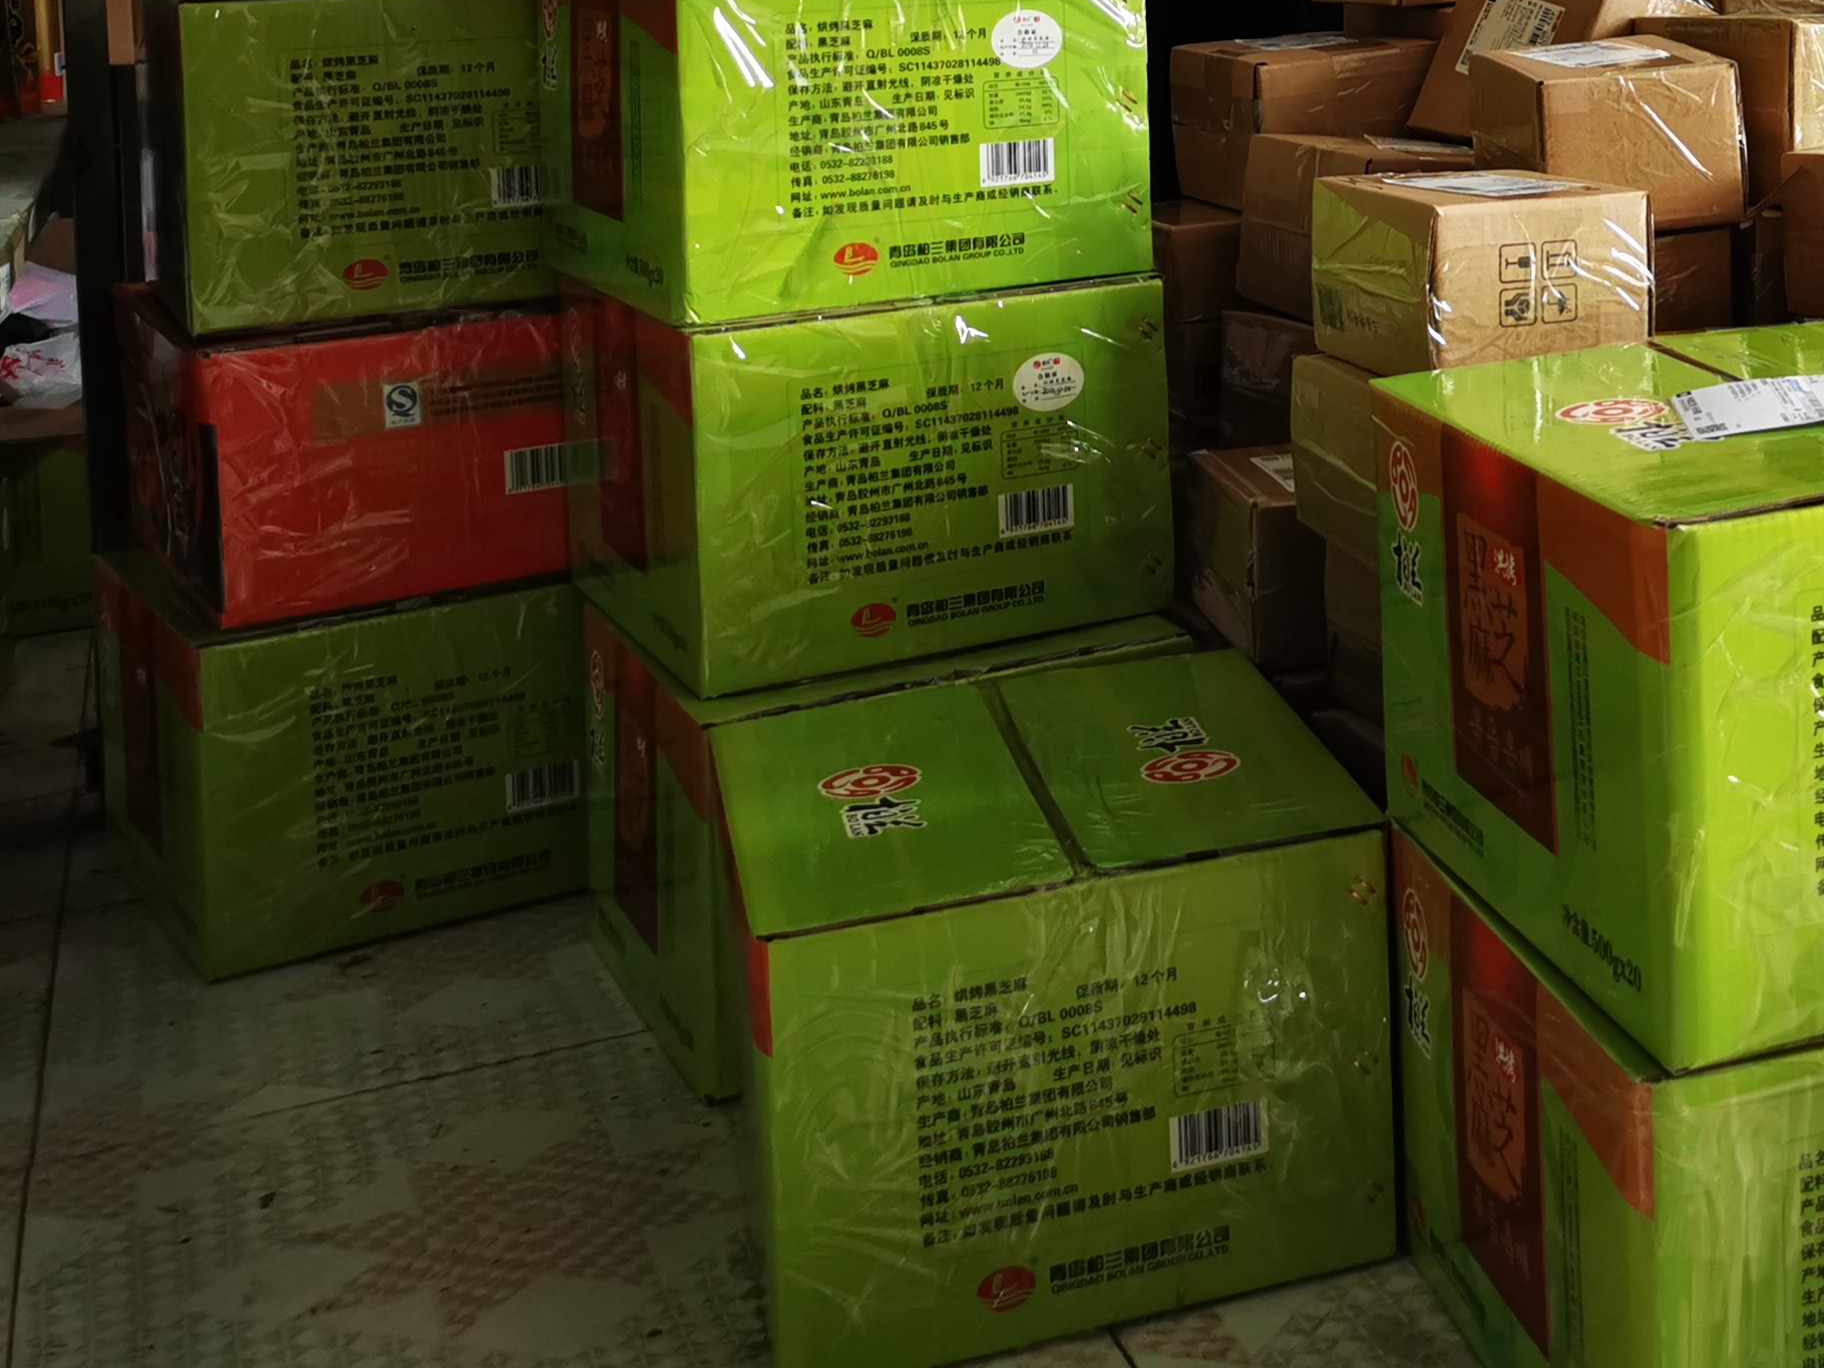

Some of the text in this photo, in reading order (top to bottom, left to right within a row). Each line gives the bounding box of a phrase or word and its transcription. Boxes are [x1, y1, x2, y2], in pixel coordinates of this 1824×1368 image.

[865, 48, 894, 59] Q/BL
[897, 46, 930, 57] 0008S
[898, 57, 1001, 72] SC11437028114498
[790, 182, 910, 203] 网址：www.bolan.com.cn
[931, 252, 960, 264] BOLAN
[882, 406, 910, 419] Q/BL
